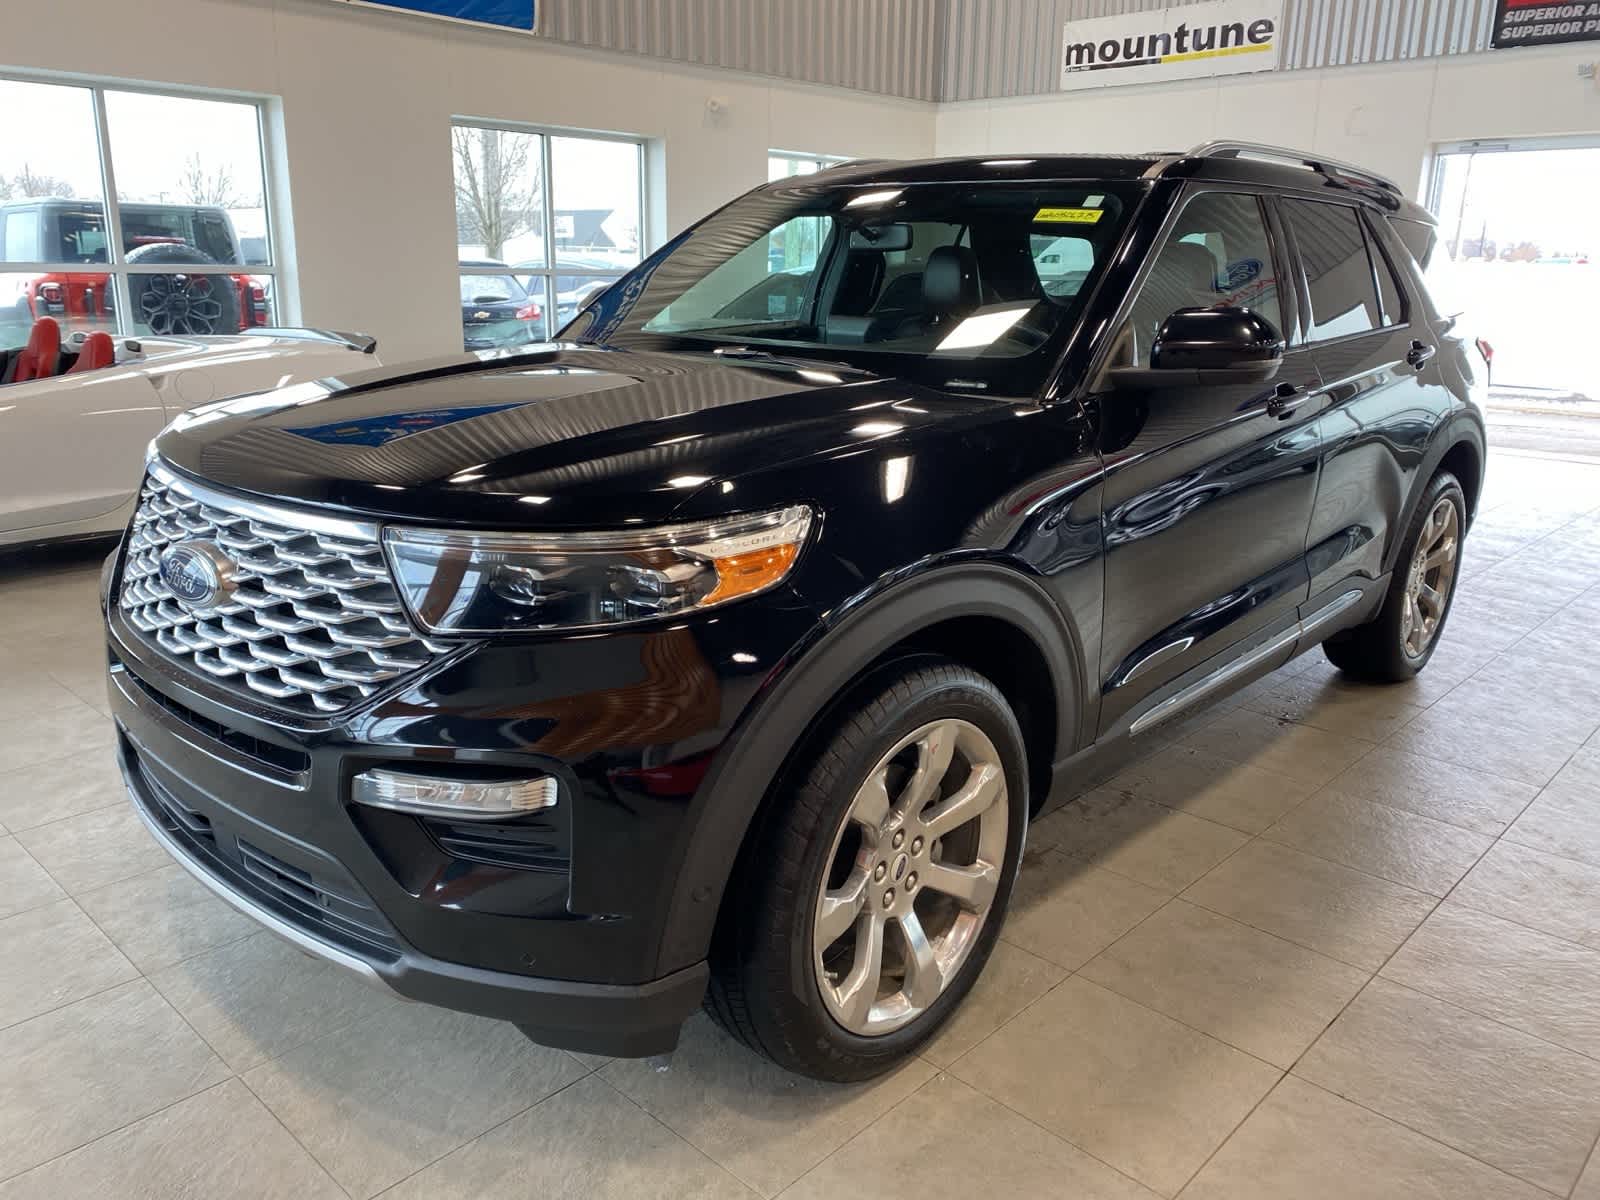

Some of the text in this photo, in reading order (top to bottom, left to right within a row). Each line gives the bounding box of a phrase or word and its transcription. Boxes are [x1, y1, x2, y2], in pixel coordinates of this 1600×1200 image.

[1503, 3, 1600, 23] SUPERIOR A
[1500, 21, 1582, 39] SUPERIOR
[1065, 18, 1274, 66] mountune
